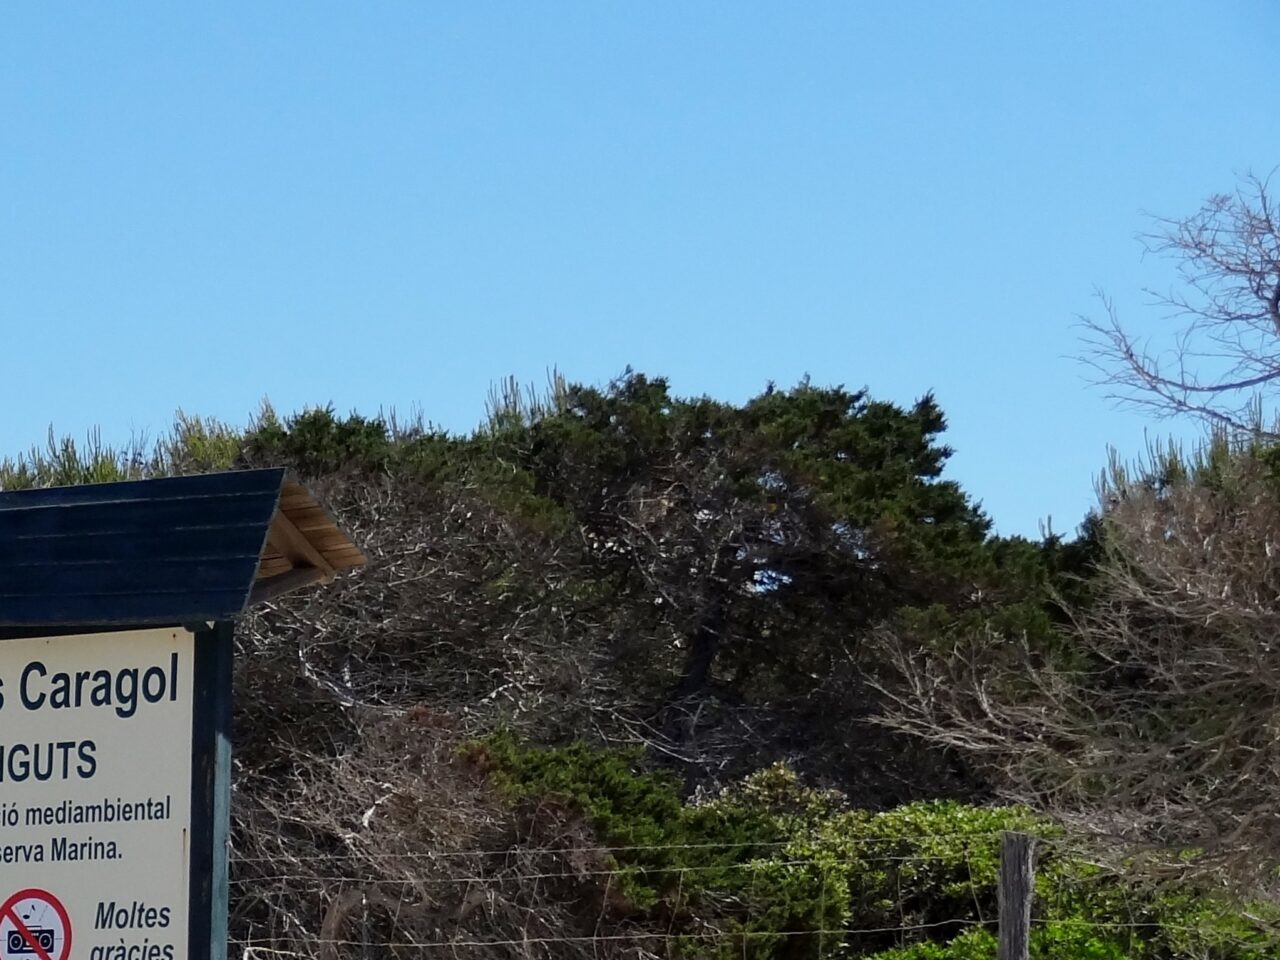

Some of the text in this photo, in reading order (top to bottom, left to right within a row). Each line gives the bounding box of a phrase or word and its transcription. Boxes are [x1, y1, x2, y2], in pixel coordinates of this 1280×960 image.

[20, 652, 178, 718] Caragol
[26, 795, 170, 825] mediambiental
[51, 836, 122, 861] Marina.
[95, 901, 171, 929] Moltes
